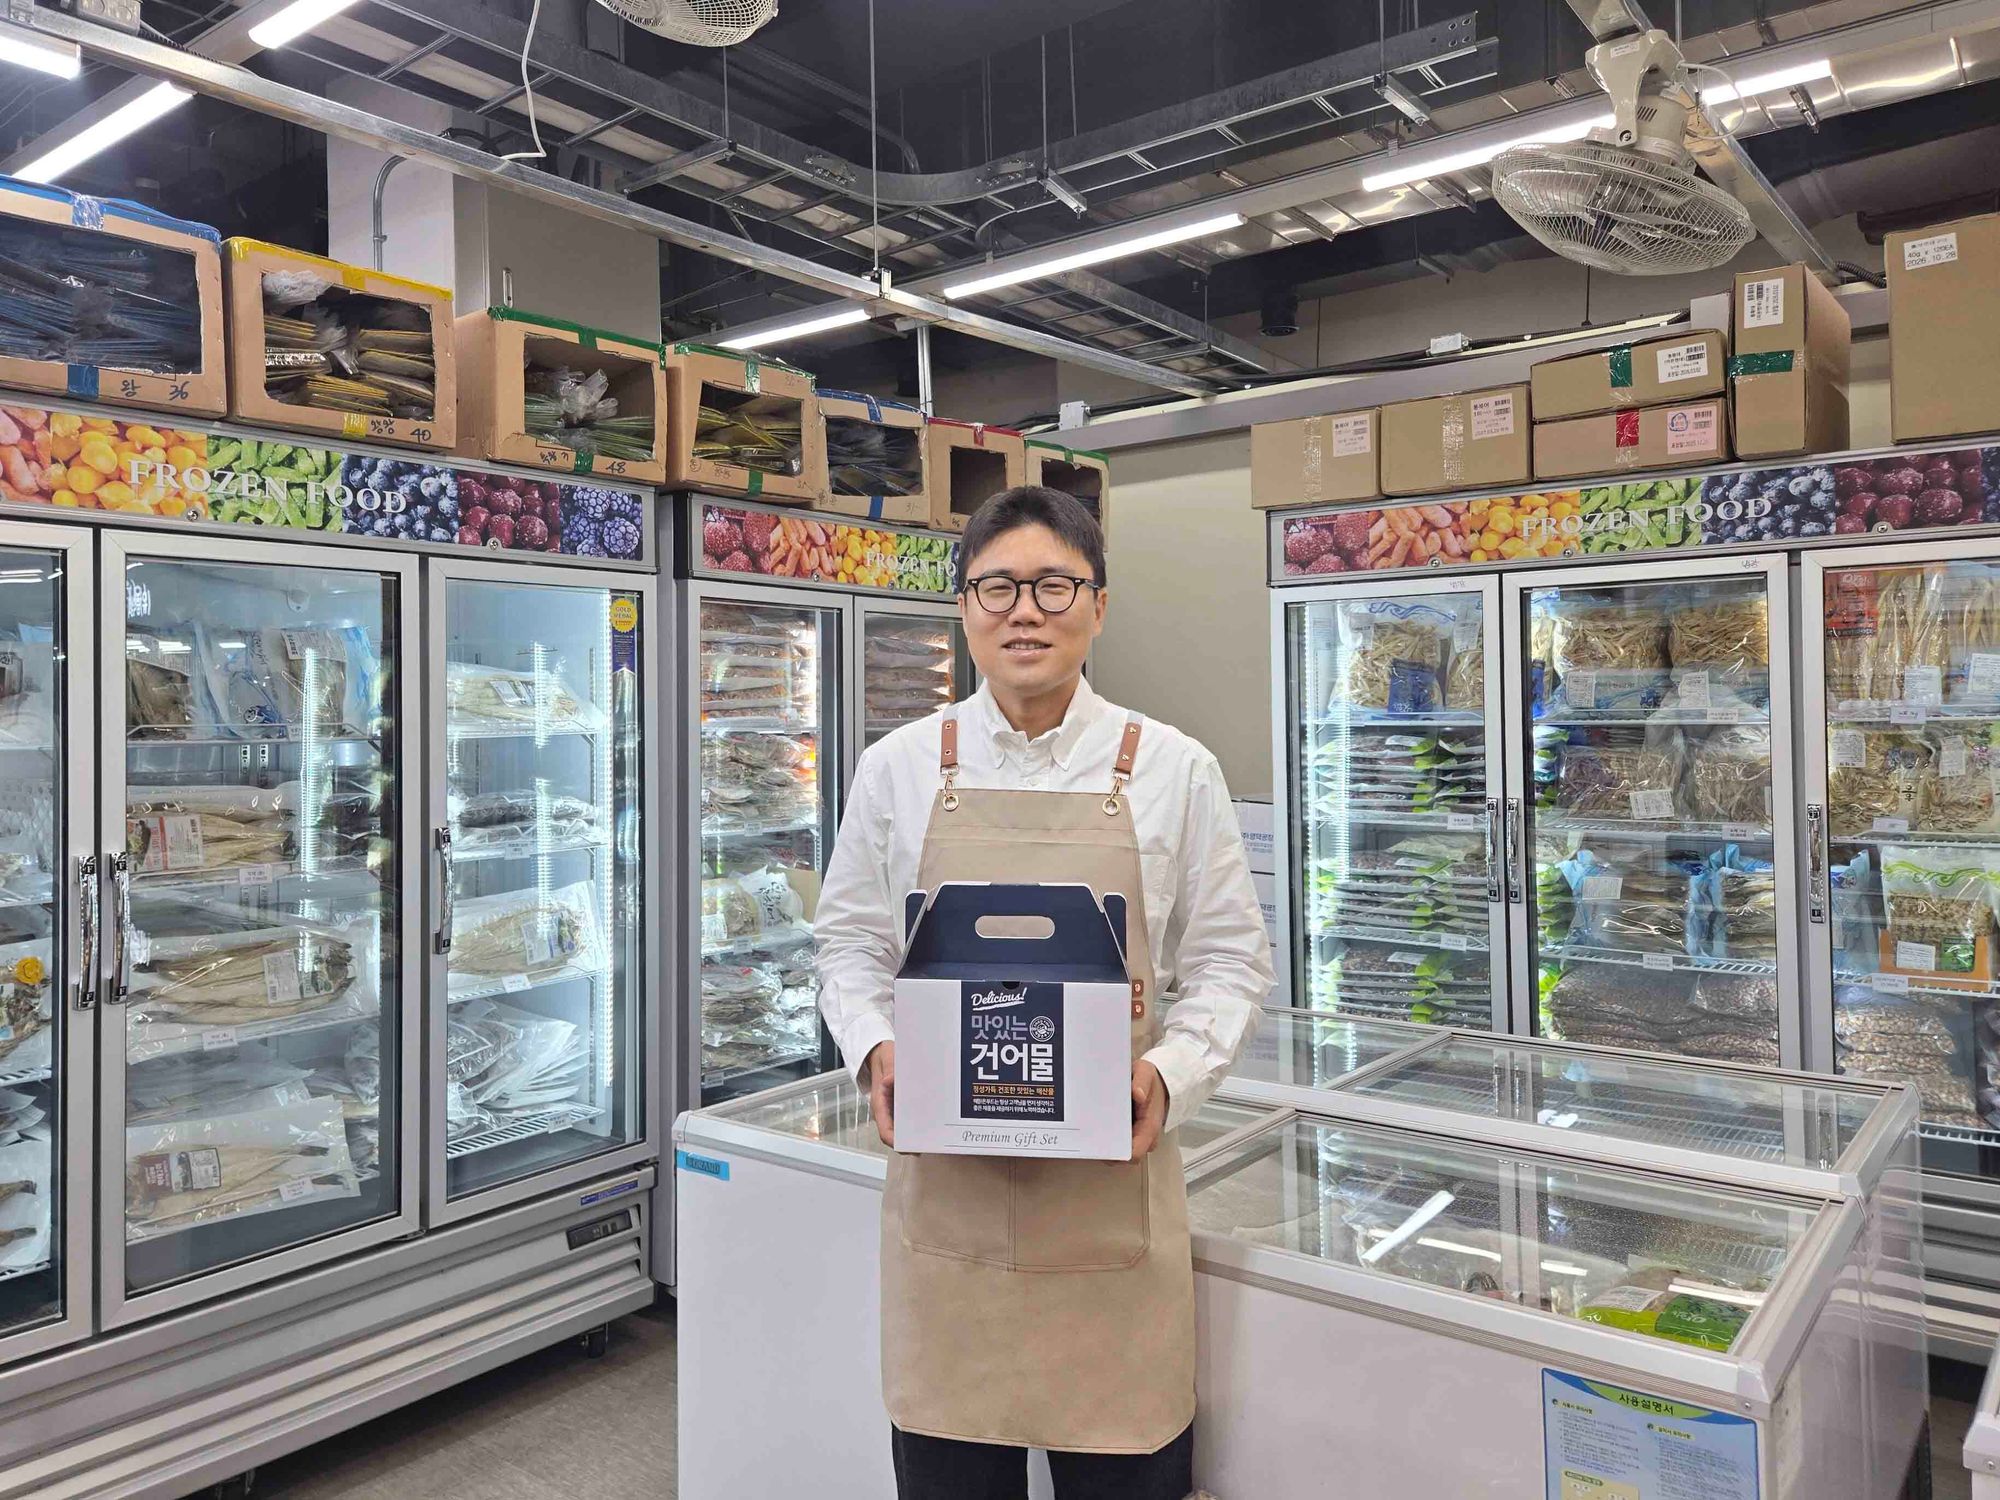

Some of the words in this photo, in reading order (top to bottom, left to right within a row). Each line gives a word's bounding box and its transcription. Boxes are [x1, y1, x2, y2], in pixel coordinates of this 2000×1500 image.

[120, 379, 141, 397] 왕
[169, 381, 190, 401] 36
[410, 428, 432, 444] 40
[606, 462, 626, 474] 48
[128, 459, 289, 502] FROZEN
[306, 481, 407, 514] FOOD
[1522, 507, 1651, 538] FROZEN
[1666, 497, 1772, 526] FOOD
[866, 551, 931, 576] FROZEN
[936, 560, 957, 578] FO
[970, 987, 1027, 1008] Delicious!
[970, 1014, 1028, 1041] 맛있는
[969, 1042, 1055, 1082] 건어물
[1017, 1086, 1035, 1095] 맛있는
[962, 1130, 1011, 1144] Premium
[1014, 1131, 1038, 1148] Gift
[1039, 1133, 1059, 1146] Set
[1618, 1392, 1675, 1416] 사용설명서
